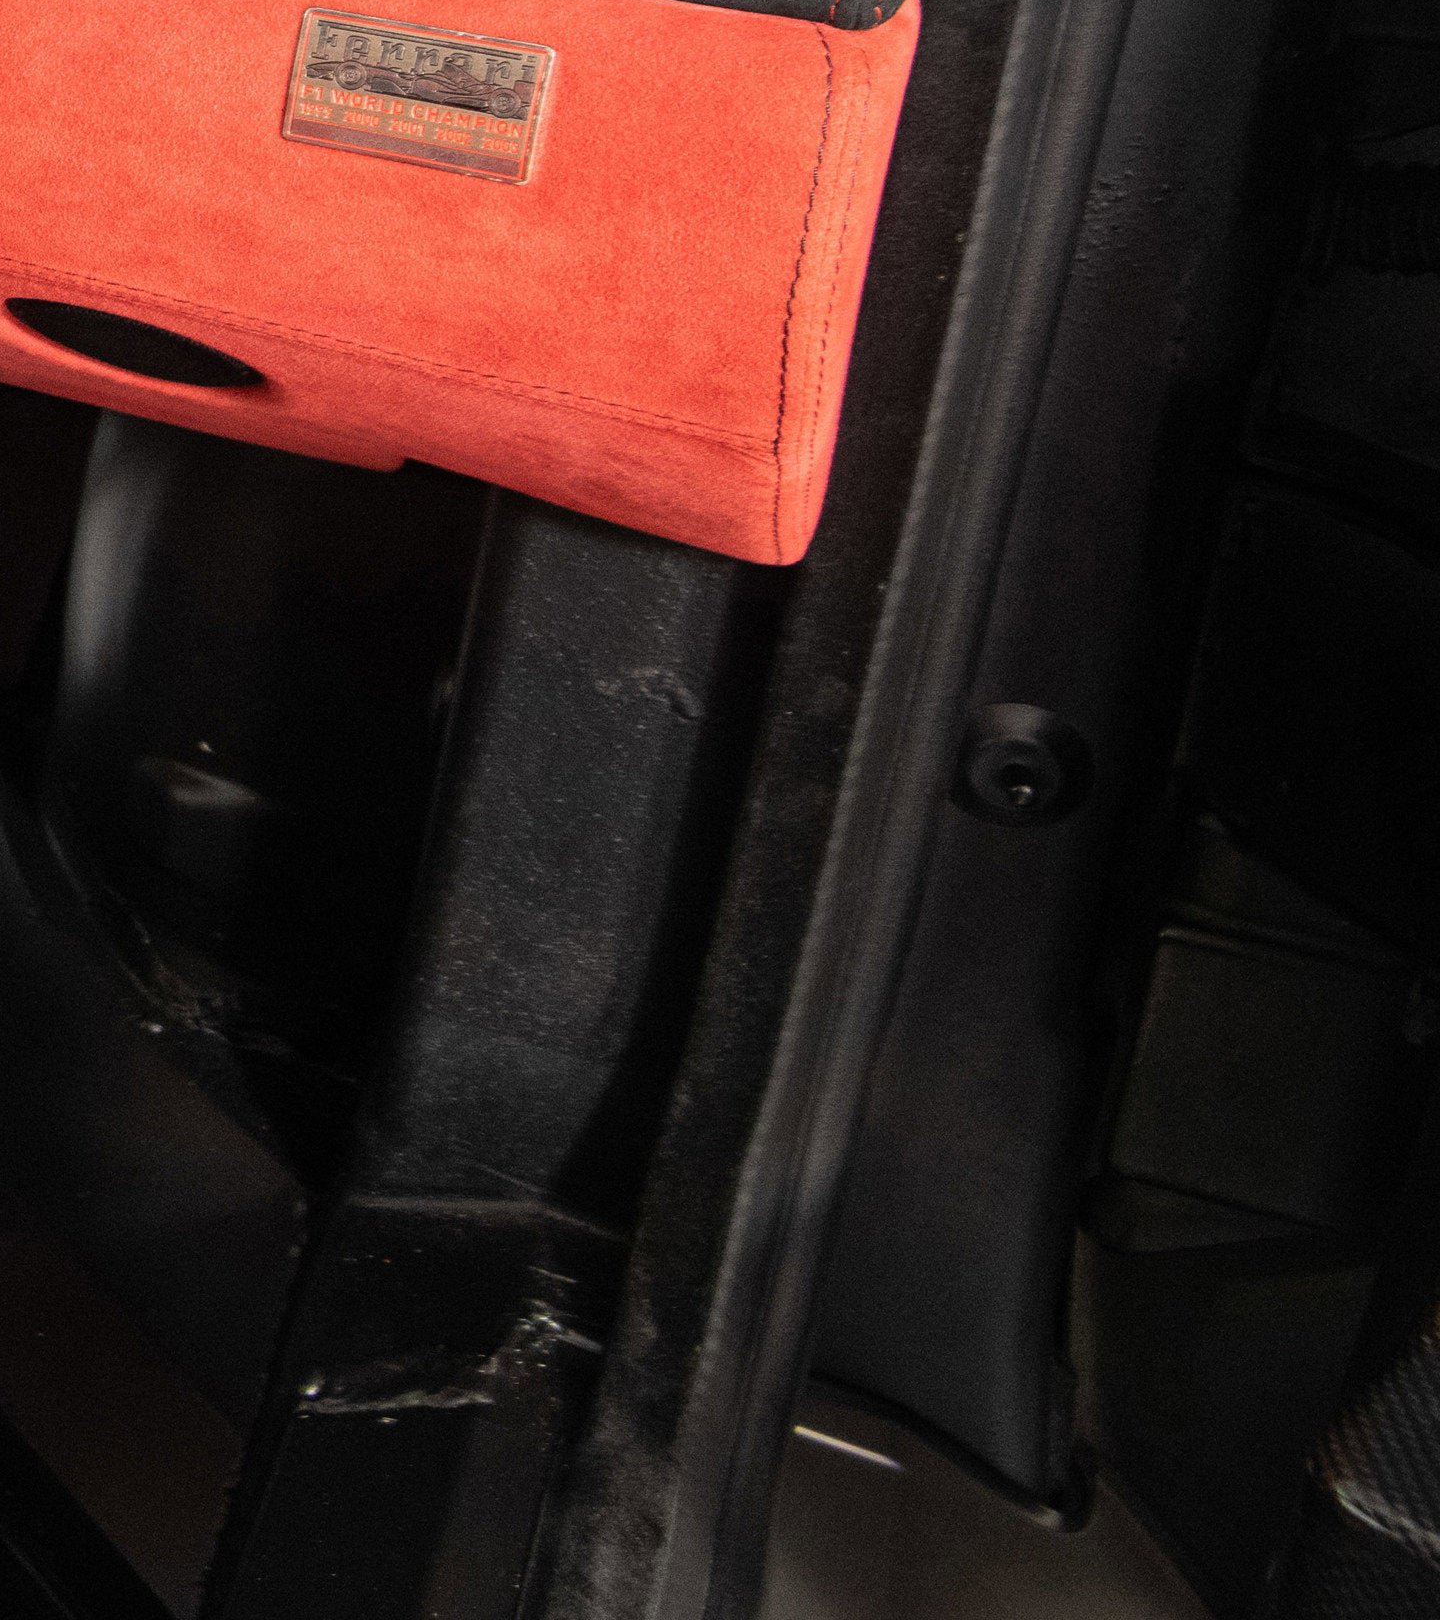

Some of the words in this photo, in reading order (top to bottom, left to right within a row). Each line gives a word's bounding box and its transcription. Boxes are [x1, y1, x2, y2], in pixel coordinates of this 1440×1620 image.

[310, 20, 537, 84] Ferrari
[301, 84, 324, 101] F1
[331, 89, 404, 116] WORLD
[411, 104, 524, 138] CHAMPION
[344, 110, 380, 127] 2000
[389, 118, 426, 137] 2001
